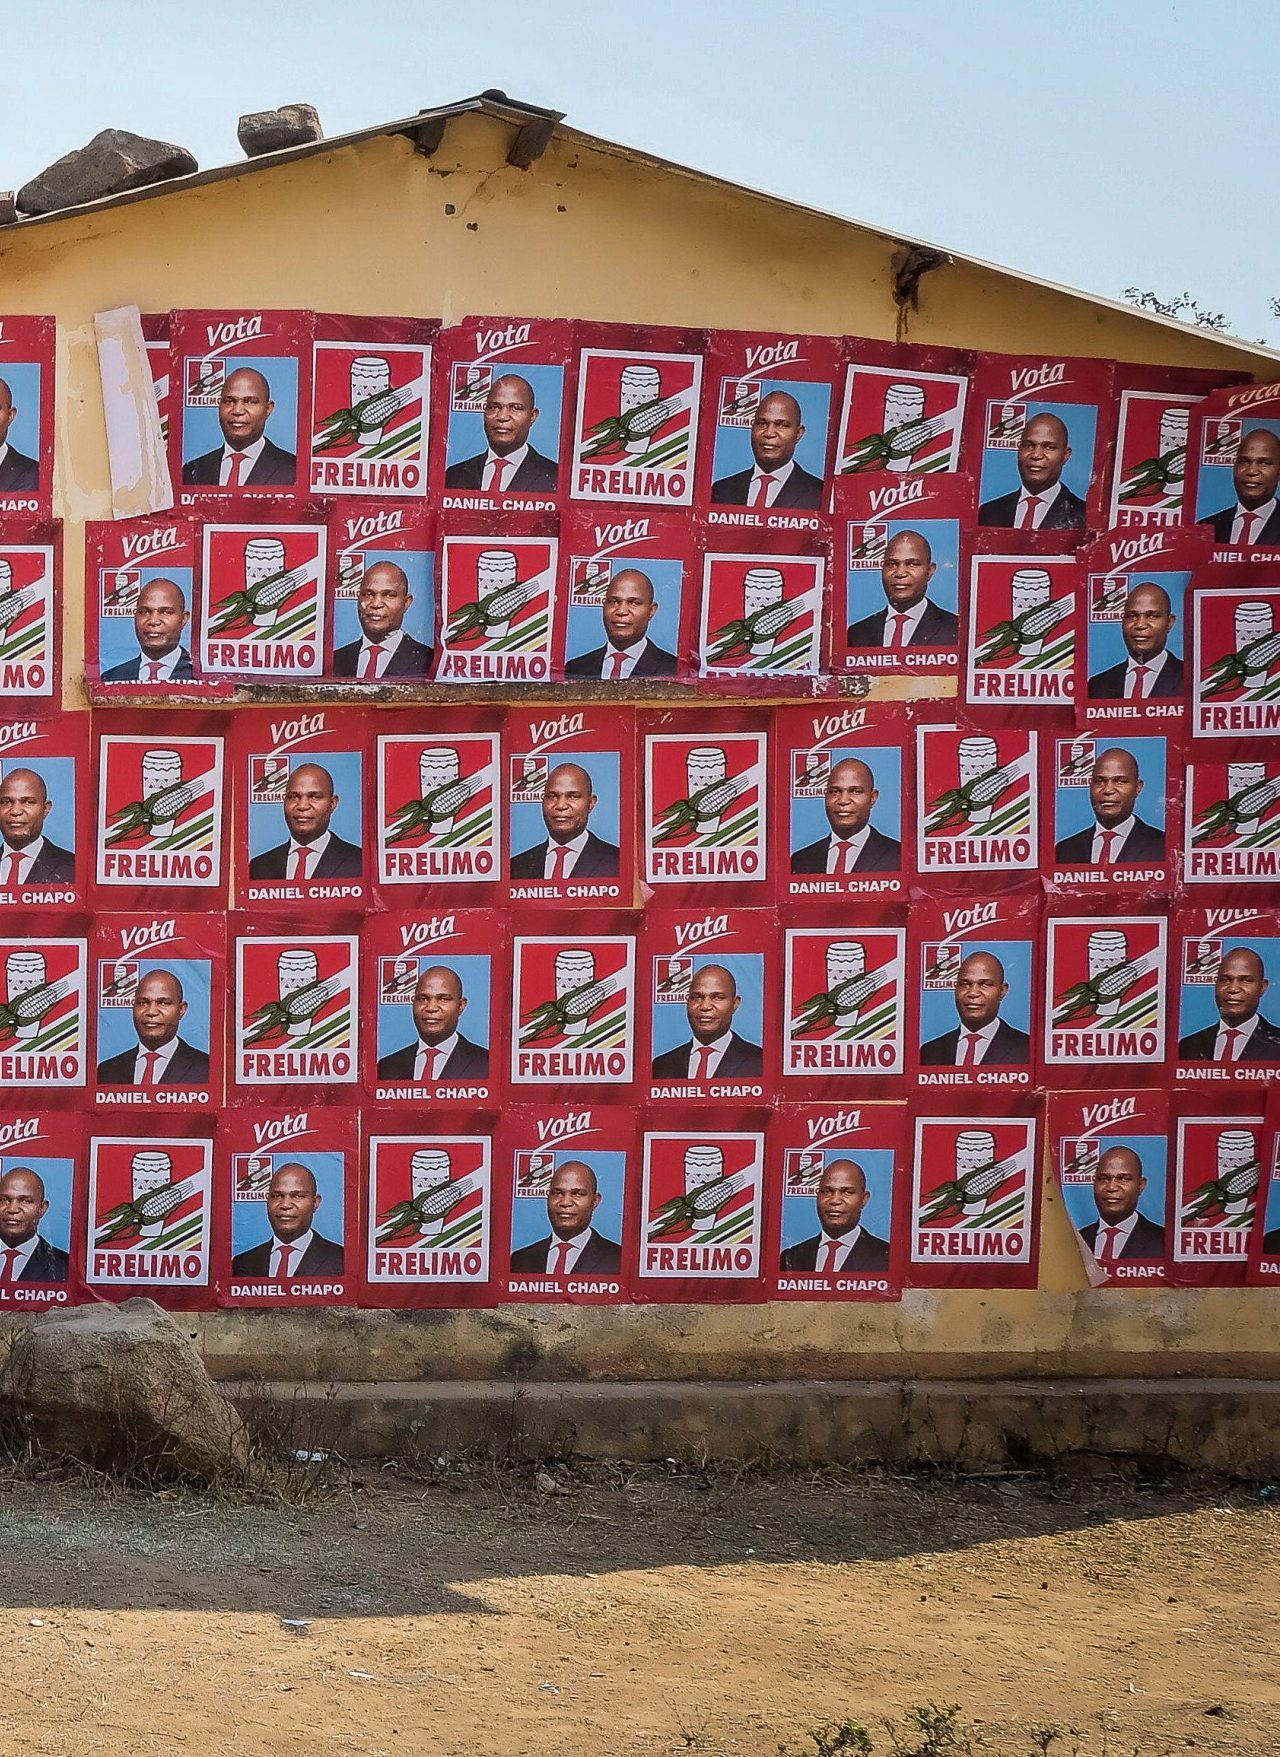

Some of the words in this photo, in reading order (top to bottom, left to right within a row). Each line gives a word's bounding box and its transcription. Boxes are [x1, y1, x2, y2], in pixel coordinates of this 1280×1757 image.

[207, 316, 262, 347] Vota
[475, 323, 530, 354] Vota
[745, 340, 798, 369] Vota
[1009, 362, 1065, 390] Vota
[312, 462, 420, 488] FRELIMO
[578, 468, 685, 497] FRELIMO
[443, 497, 500, 510] DANIEL
[502, 500, 555, 510] CHAPO
[869, 478, 924, 510] Vota
[346, 510, 402, 541] Vota
[709, 512, 763, 526] DANIEL
[768, 516, 818, 530] CHAPO
[121, 527, 176, 558] Vota
[594, 519, 649, 548] Vota
[1109, 532, 1164, 563] Vota
[208, 644, 315, 668] FRELIMO
[846, 655, 901, 666] DANIEL
[906, 654, 957, 665] CHAPO
[974, 674, 1076, 697] FRELIMO
[812, 708, 867, 739] Vota
[1087, 707, 1141, 718] DANIEL
[270, 713, 325, 742] Vota
[529, 713, 584, 744] Vota
[386, 851, 493, 876] FRELIMO
[652, 850, 758, 875] FRELIMO
[925, 838, 1030, 865] FRELIMO
[1192, 852, 1280, 875] FRELIM
[105, 854, 212, 878] FRELIMO
[1054, 872, 1109, 884] DANIEL
[1113, 870, 1164, 882] CHAPO
[22, 892, 75, 903] CHAPO
[249, 888, 304, 899] DANIEL
[309, 886, 362, 898] CHAPO
[510, 887, 562, 898] DANIEL
[567, 886, 619, 897] CHAPO
[790, 882, 844, 893] DANIEL
[848, 880, 900, 892] CHAPO
[674, 914, 728, 946] Vota
[942, 902, 998, 934] Vota
[120, 920, 175, 950] Vota
[400, 915, 455, 947] Vota
[791, 1044, 896, 1068] FRELIMO
[1052, 1032, 1157, 1056] FRELIMO
[243, 1052, 350, 1077] FRELIMO
[519, 1053, 625, 1076] FRELIMO
[1176, 1068, 1230, 1079] DANIEL
[918, 1074, 973, 1084] DANIEL
[977, 1072, 1028, 1083] CHAPO
[96, 1093, 151, 1103] DANIEL
[156, 1092, 208, 1103] CHAPO
[376, 1088, 431, 1099] DANIEL
[436, 1088, 488, 1098] CHAPO
[651, 1087, 706, 1098] DANIEL
[710, 1086, 762, 1097] CHAPO
[1081, 1096, 1136, 1127] Vota
[253, 1112, 308, 1143] Vota
[537, 1111, 591, 1140] Vota
[807, 1110, 861, 1139] Vota
[918, 1233, 1023, 1256] FRELIMO
[94, 1254, 201, 1278] FRELIMO
[376, 1252, 481, 1275] FRELIMO
[647, 1248, 752, 1271] FRELIMO
[1116, 1266, 1164, 1277] CHAPO
[15, 1290, 67, 1301] CHAPO
[232, 1285, 286, 1296] DANIEL
[291, 1285, 343, 1295] CHAPO
[509, 1282, 563, 1292] DANIEL
[568, 1282, 619, 1293] CHAPO
[778, 1280, 832, 1290] DANIEL
[836, 1280, 888, 1290] CHAPO
